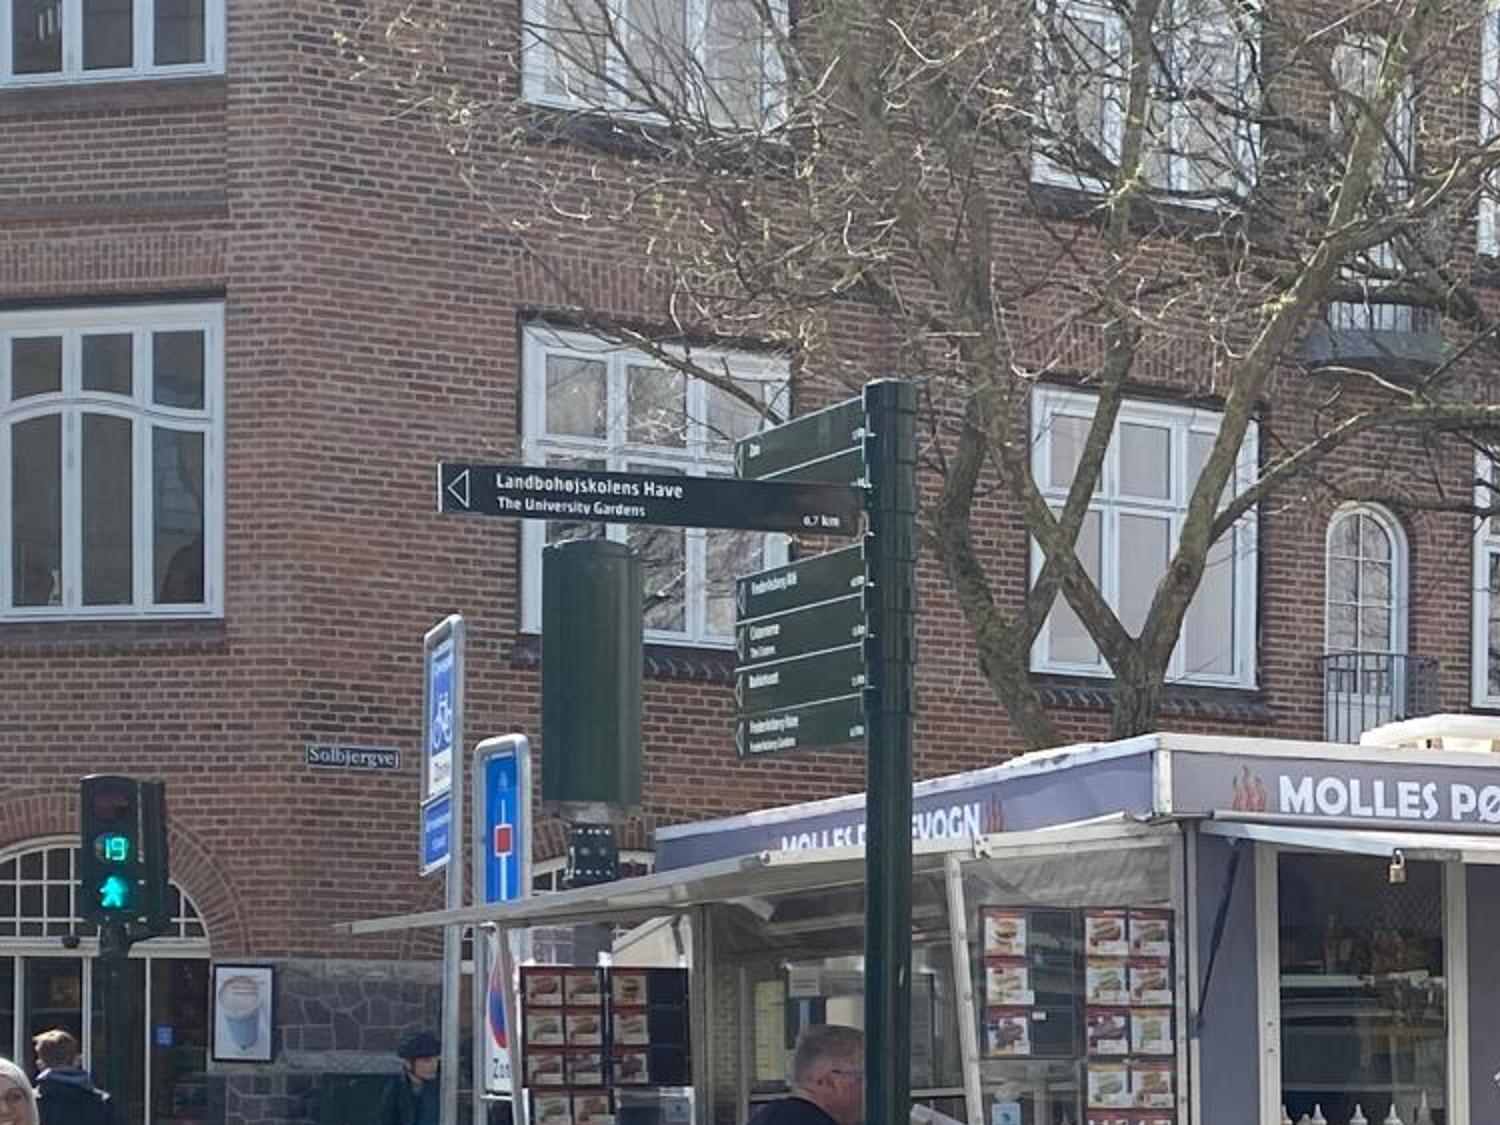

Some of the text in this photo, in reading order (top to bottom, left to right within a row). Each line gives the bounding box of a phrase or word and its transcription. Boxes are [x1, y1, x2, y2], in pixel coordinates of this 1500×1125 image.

[496, 473, 685, 499] Landbohøjskolens Have
[497, 496, 646, 517] The University Gardens
[821, 514, 840, 528] km
[309, 747, 399, 769] Solbjergvej
[1279, 775, 1439, 820] MOLLES
[105, 837, 126, 861] 19
